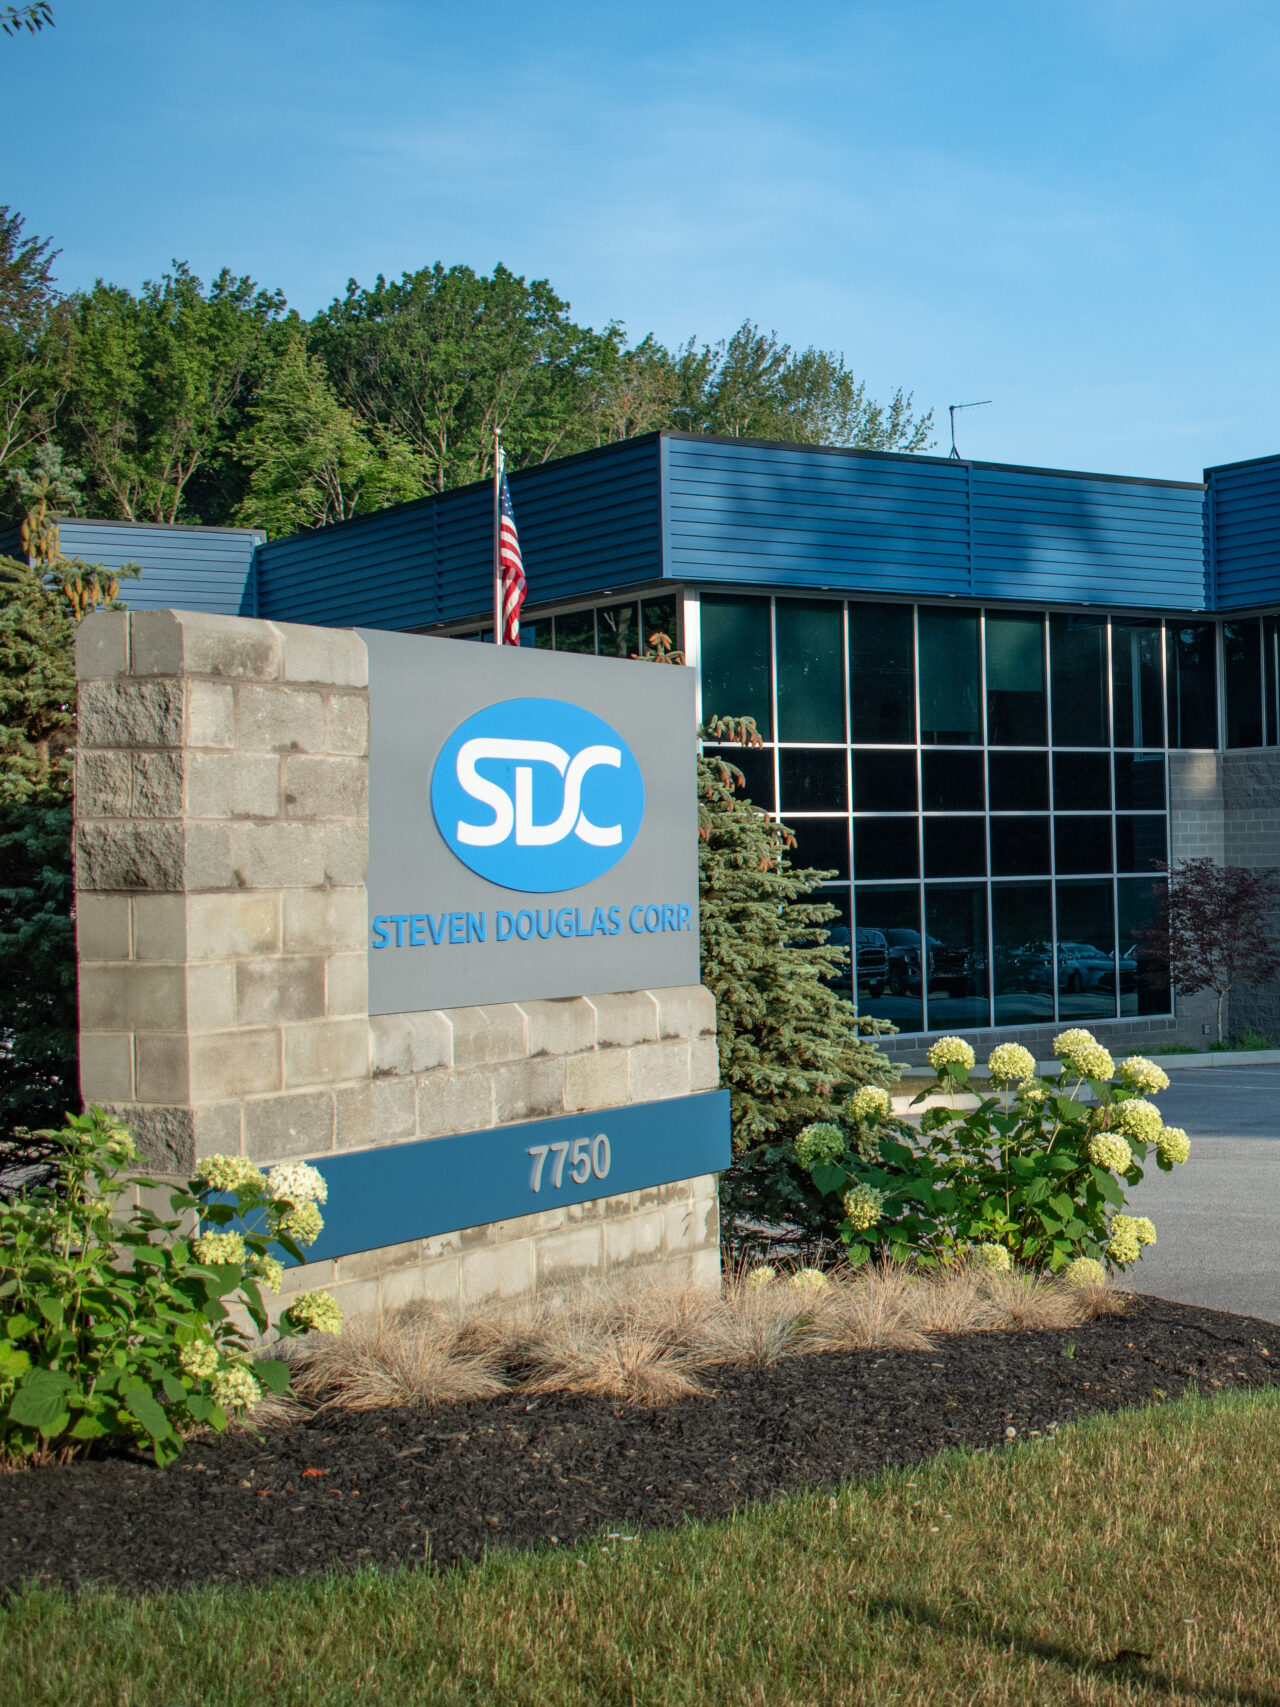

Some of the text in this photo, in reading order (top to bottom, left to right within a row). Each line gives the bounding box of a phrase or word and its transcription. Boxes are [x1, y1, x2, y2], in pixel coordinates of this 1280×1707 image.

[456, 738, 622, 846] SDC
[372, 903, 693, 948] STEVEN DOUGLAS CORP.
[527, 1133, 611, 1193] 7750
